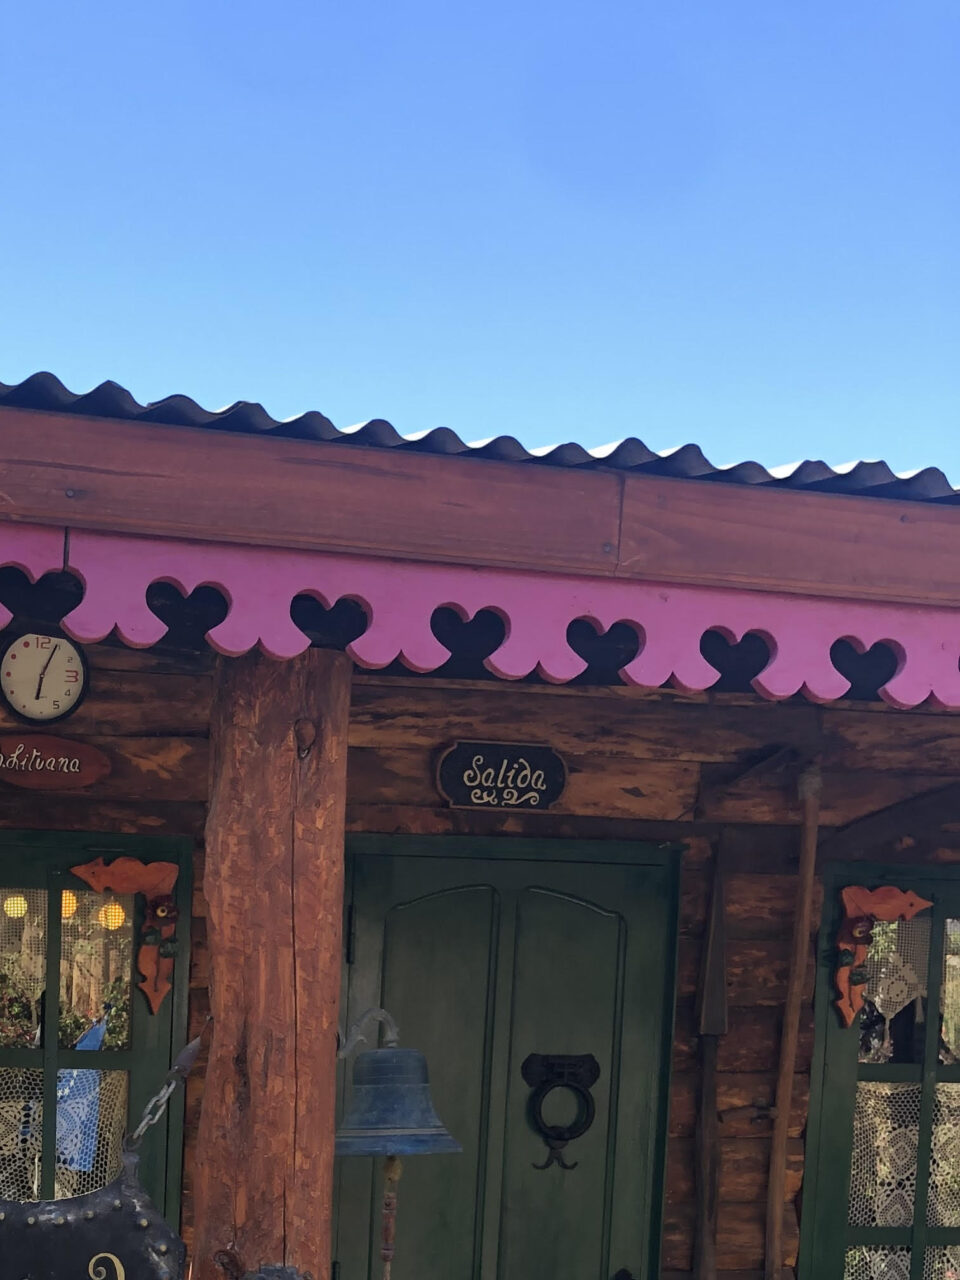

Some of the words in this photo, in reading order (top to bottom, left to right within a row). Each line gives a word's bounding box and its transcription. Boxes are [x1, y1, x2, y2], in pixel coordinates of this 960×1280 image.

[35, 636, 52, 650] 12
[65, 656, 74, 664] 2
[64, 669, 80, 683] 3
[64, 688, 72, 697] 4
[52, 700, 61, 710] 5
[463, 755, 547, 790] Salida
